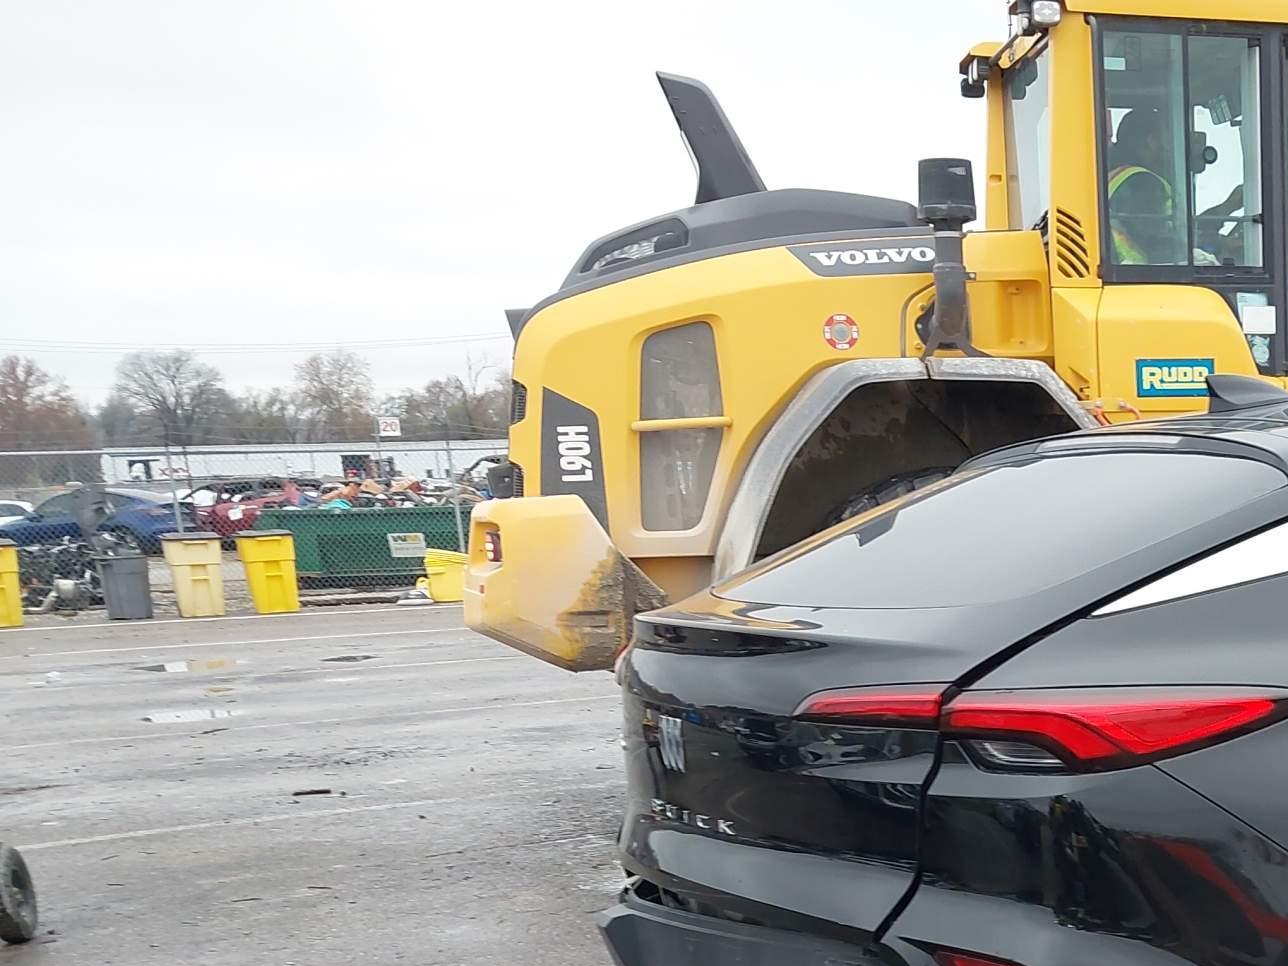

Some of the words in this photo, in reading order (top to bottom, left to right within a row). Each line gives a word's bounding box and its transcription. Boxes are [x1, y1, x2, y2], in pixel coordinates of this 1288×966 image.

[809, 247, 936, 266] VOLVO
[1142, 366, 1209, 390] RUDD
[556, 425, 593, 482] L90H
[651, 798, 737, 836] BUICK
